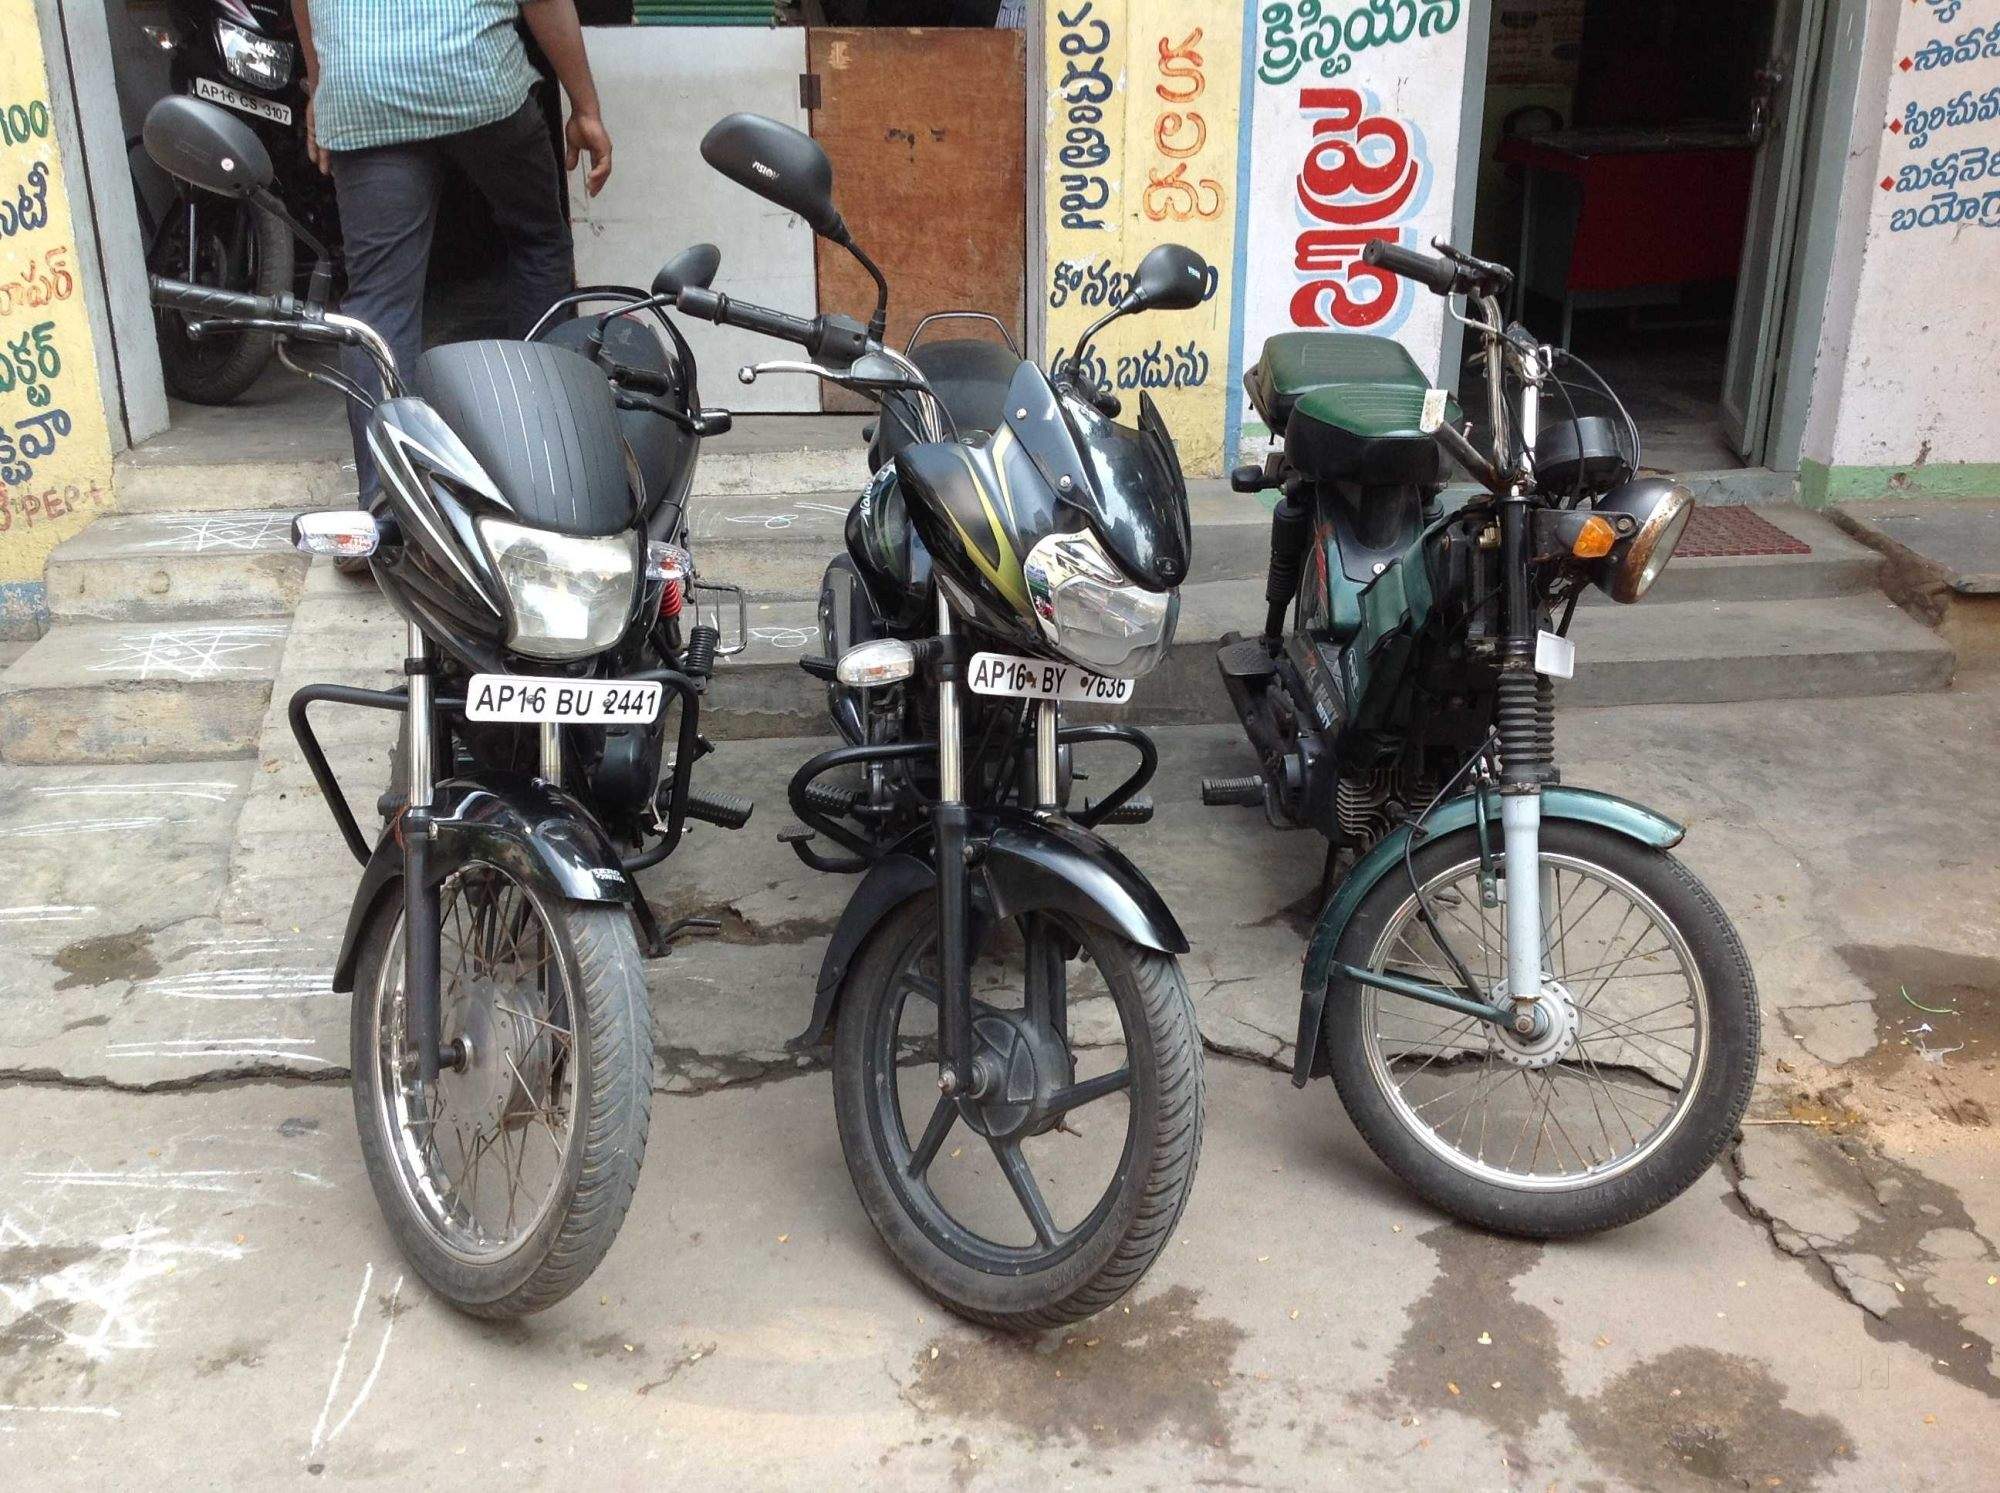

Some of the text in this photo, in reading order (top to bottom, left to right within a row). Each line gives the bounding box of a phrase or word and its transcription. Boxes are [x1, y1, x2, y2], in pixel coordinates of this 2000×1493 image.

[201, 84, 289, 122] AP16 CS 3107
[974, 659, 1027, 691] AP16
[1042, 666, 1067, 694] BY
[475, 684, 656, 716] AP16 BU 2441
